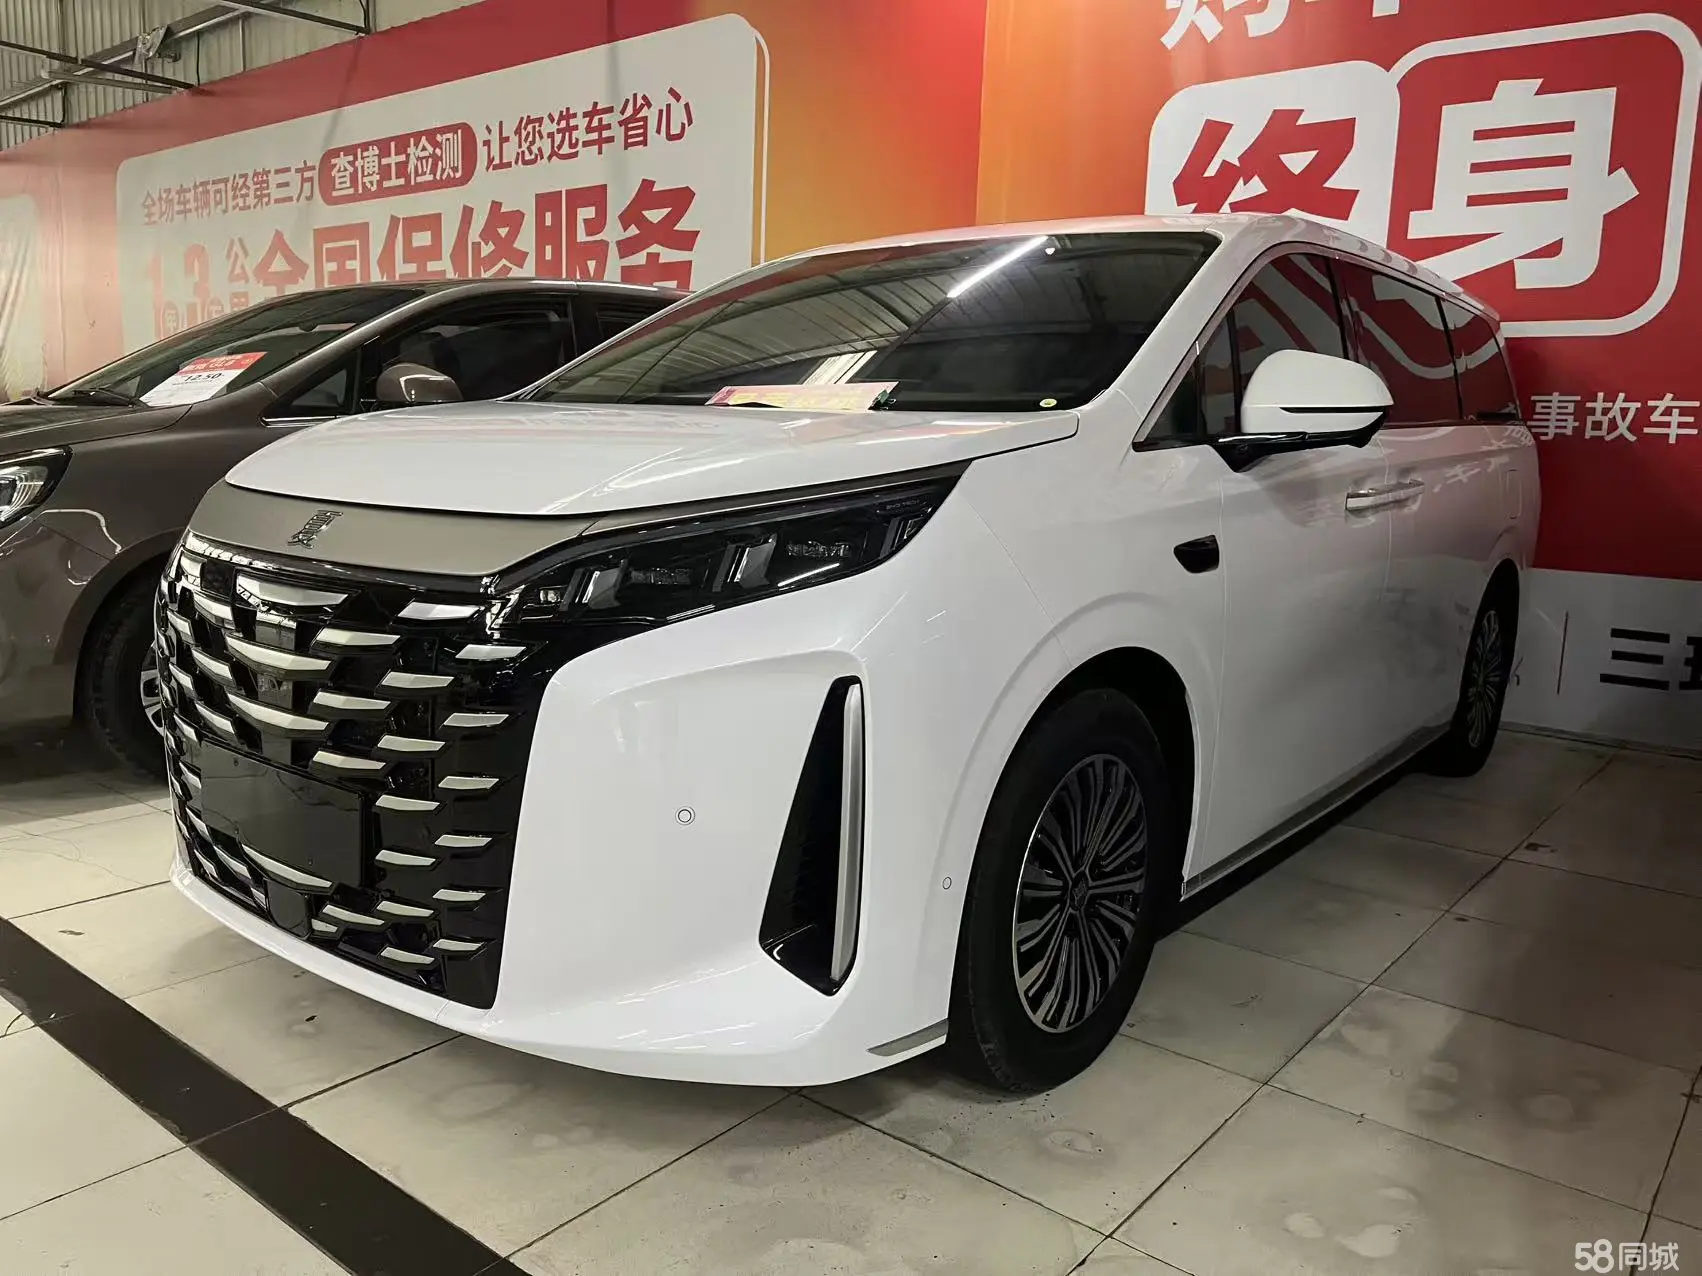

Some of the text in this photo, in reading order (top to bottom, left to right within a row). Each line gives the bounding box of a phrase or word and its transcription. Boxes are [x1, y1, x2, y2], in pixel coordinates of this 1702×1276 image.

[141, 86, 694, 226] 全场车辆可经第三方 查博士检测 让您选车省心
[1527, 391, 1701, 444] 事故车
